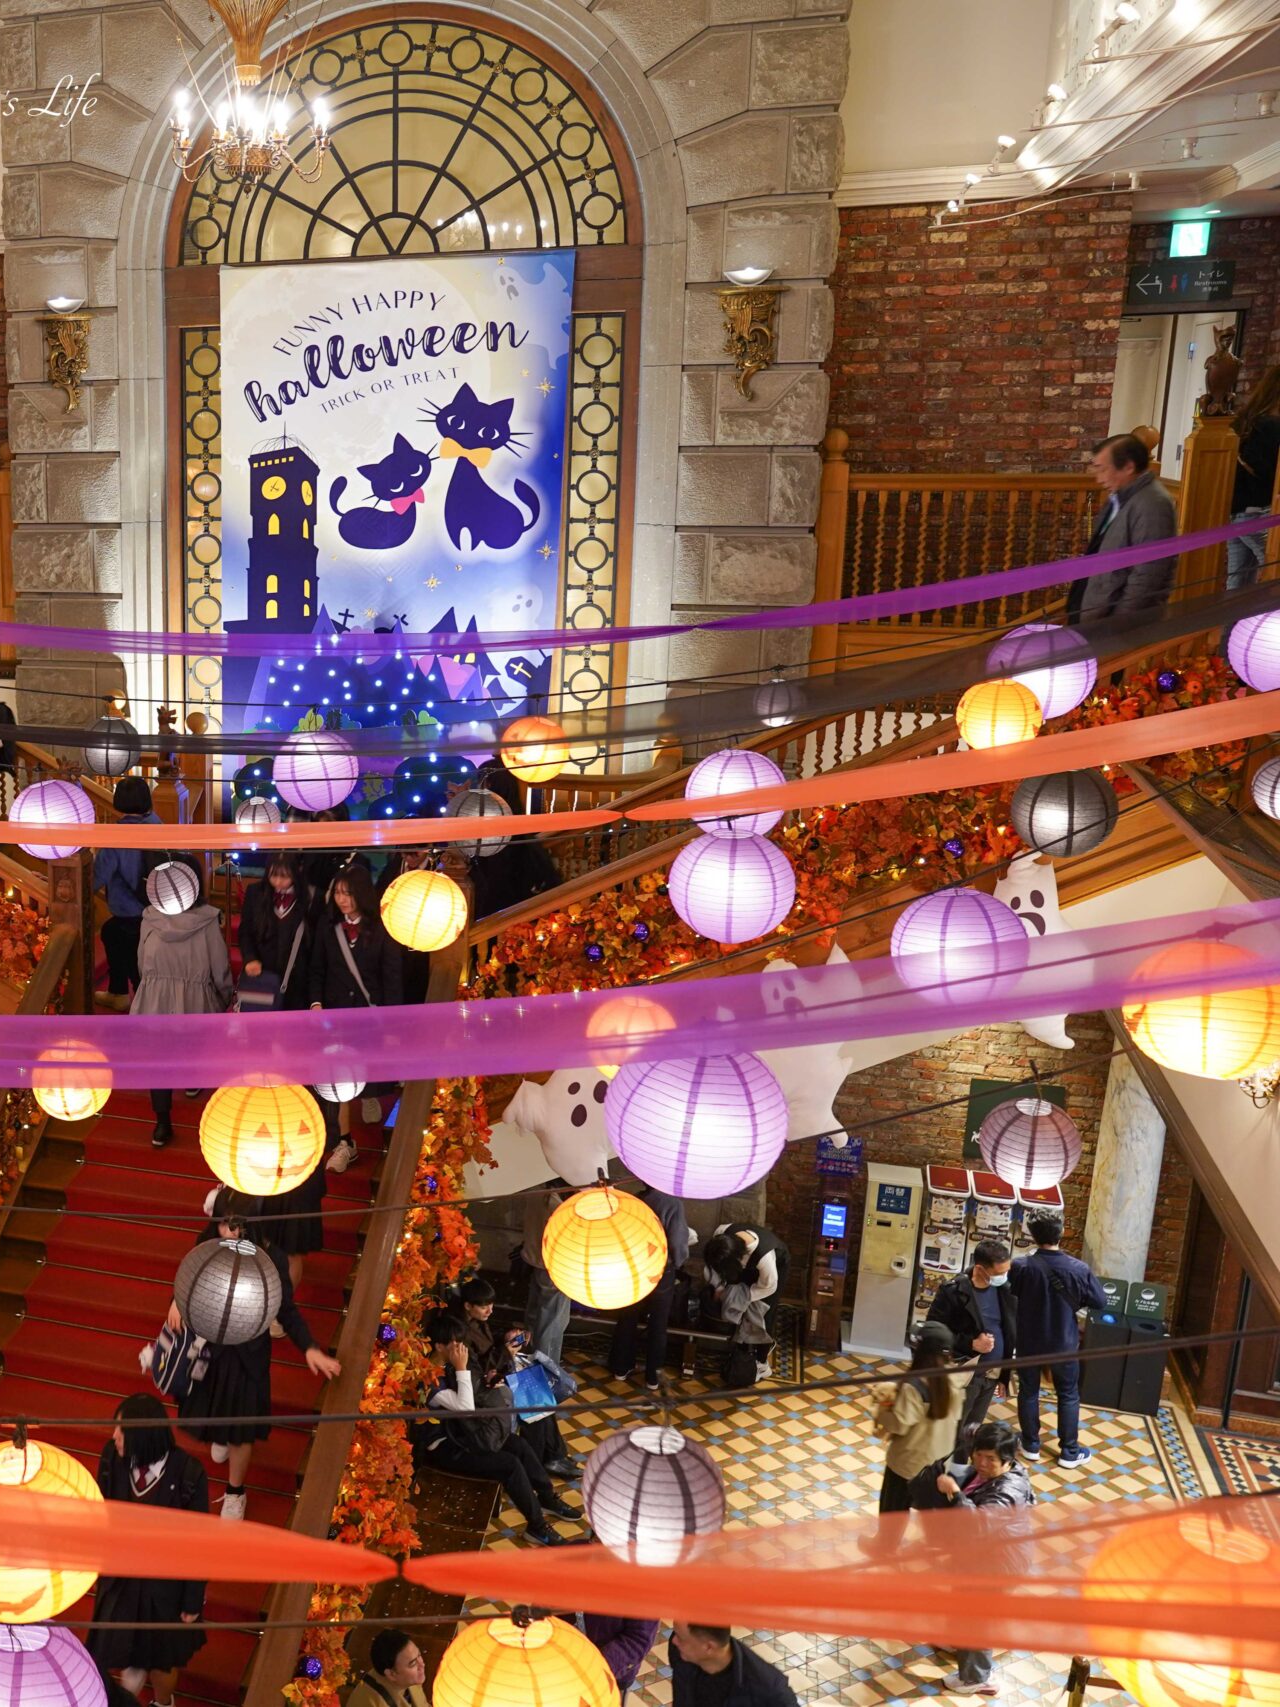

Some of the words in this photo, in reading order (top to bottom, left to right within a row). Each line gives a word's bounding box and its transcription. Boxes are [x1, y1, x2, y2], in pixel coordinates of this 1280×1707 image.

[1198, 270, 1225, 279] トイレ
[272, 302, 344, 356] FUNNY
[352, 290, 447, 315] HAPPY
[243, 321, 530, 423] halloween
[319, 389, 367, 414] TRICK
[370, 378, 395, 394] OR
[400, 366, 461, 387] TREAT
